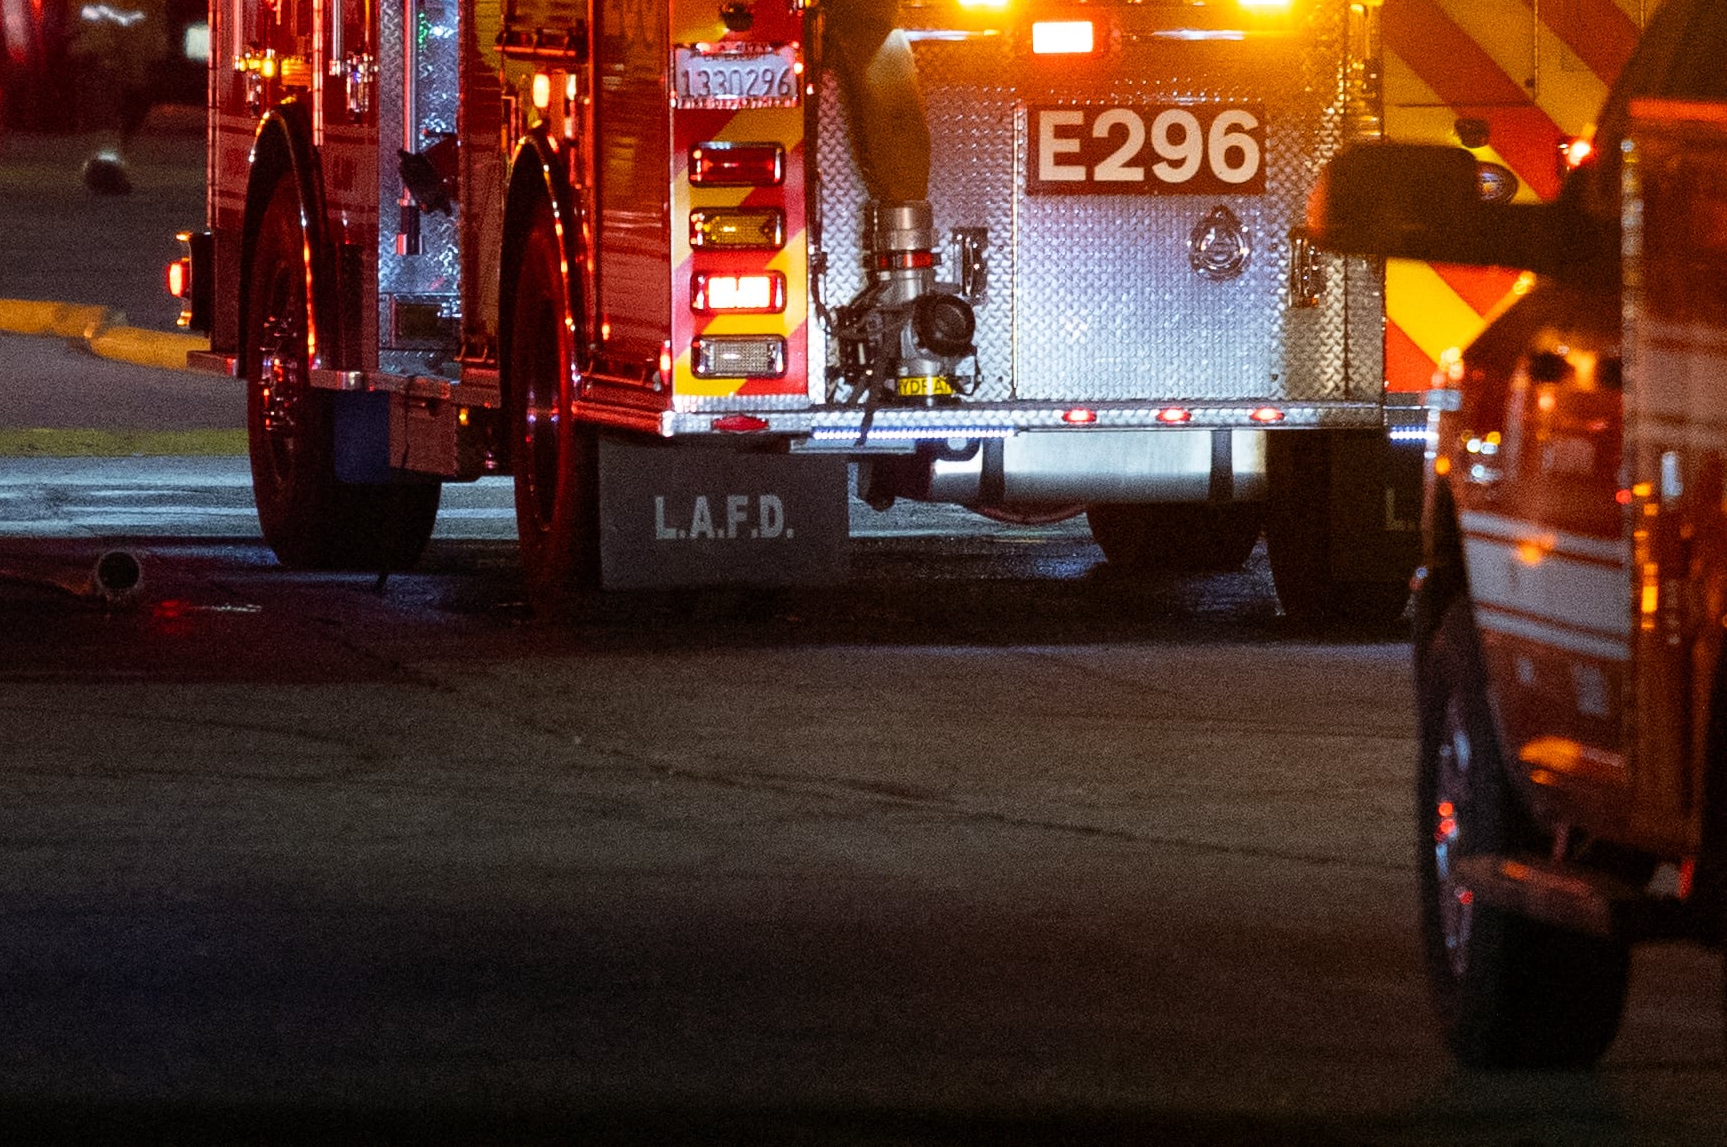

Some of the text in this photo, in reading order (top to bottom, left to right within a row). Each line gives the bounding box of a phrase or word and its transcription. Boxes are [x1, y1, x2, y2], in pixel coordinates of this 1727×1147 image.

[679, 67, 792, 98] 1330296
[1037, 109, 1261, 185] E296
[654, 493, 795, 542] L.A.F.D.
